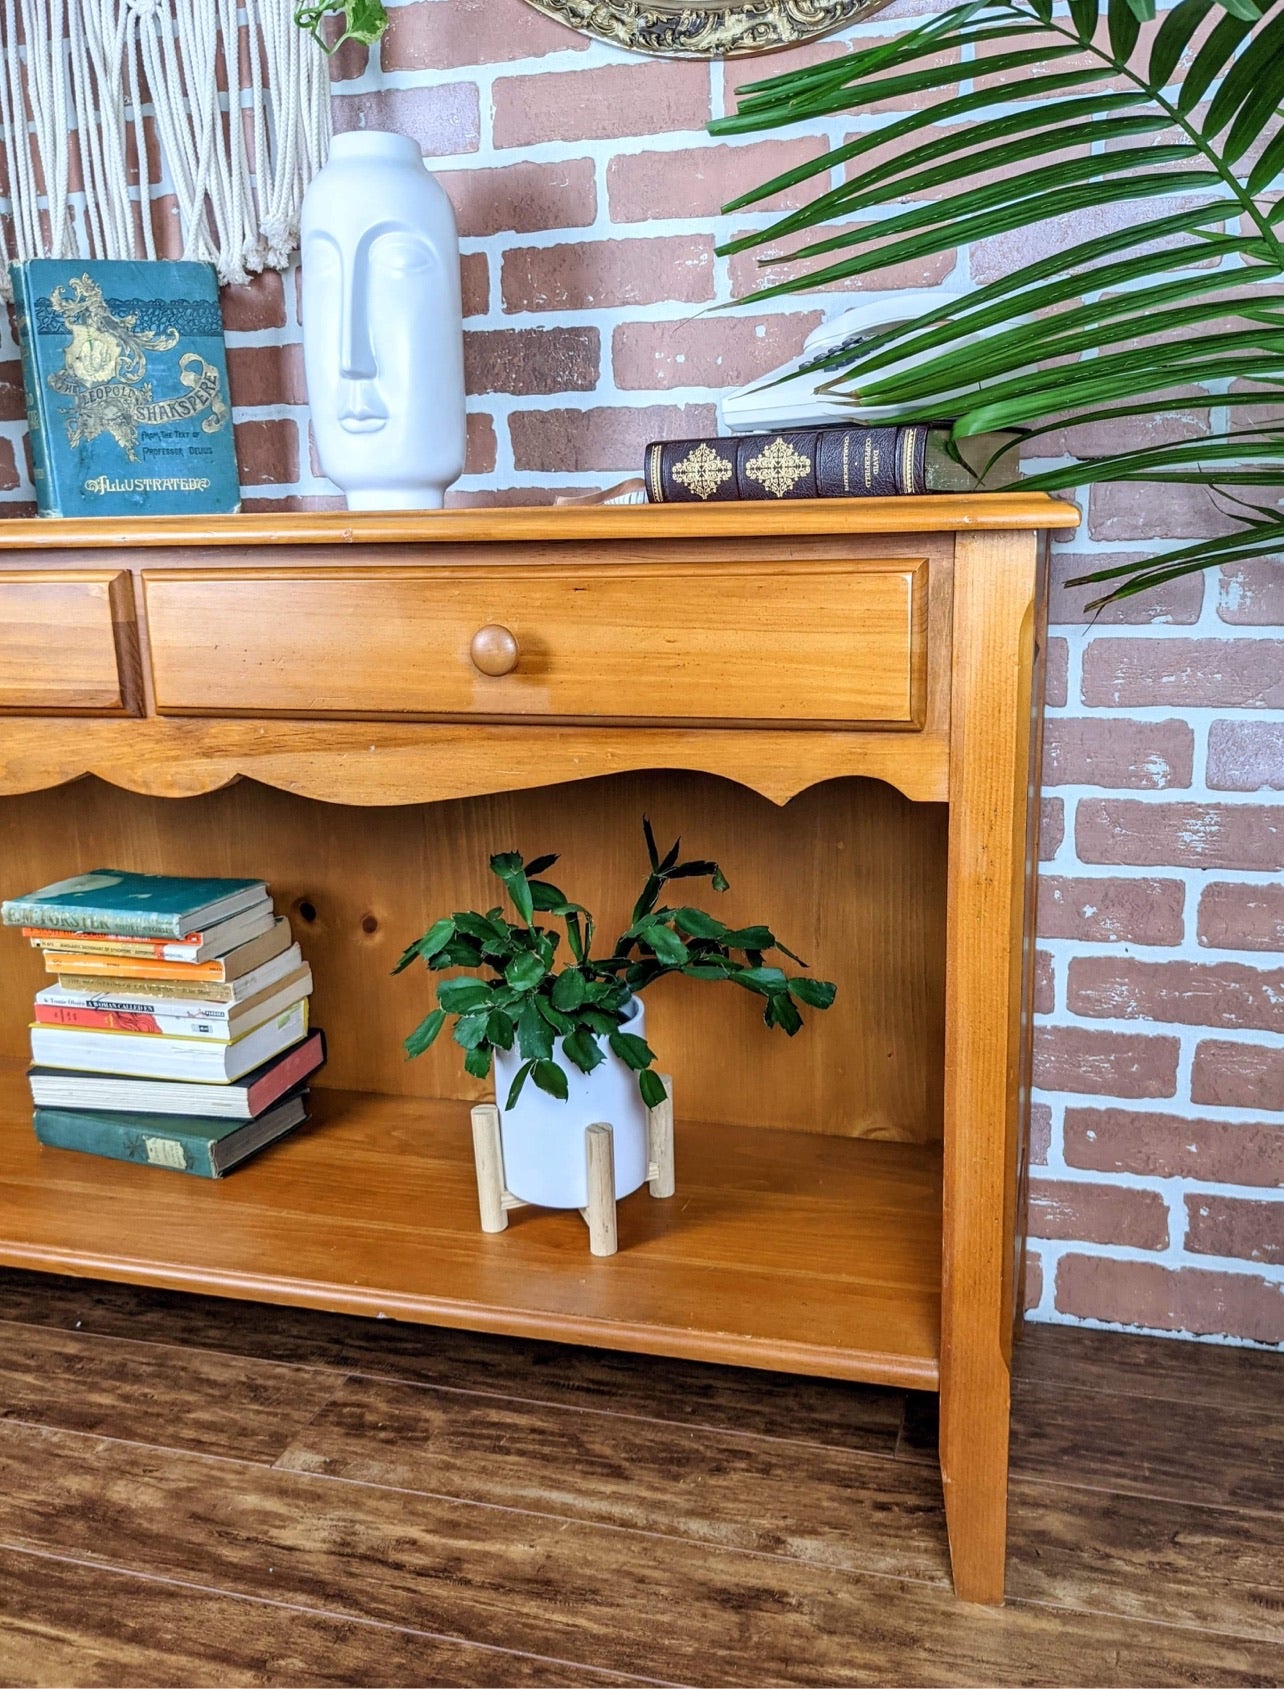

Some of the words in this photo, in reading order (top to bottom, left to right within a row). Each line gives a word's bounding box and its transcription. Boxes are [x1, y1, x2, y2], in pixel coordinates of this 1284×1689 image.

[82, 385, 136, 405] LEOPOLD
[136, 372, 217, 422] SHAKSPERE
[142, 447, 185, 461] PROFESSOR
